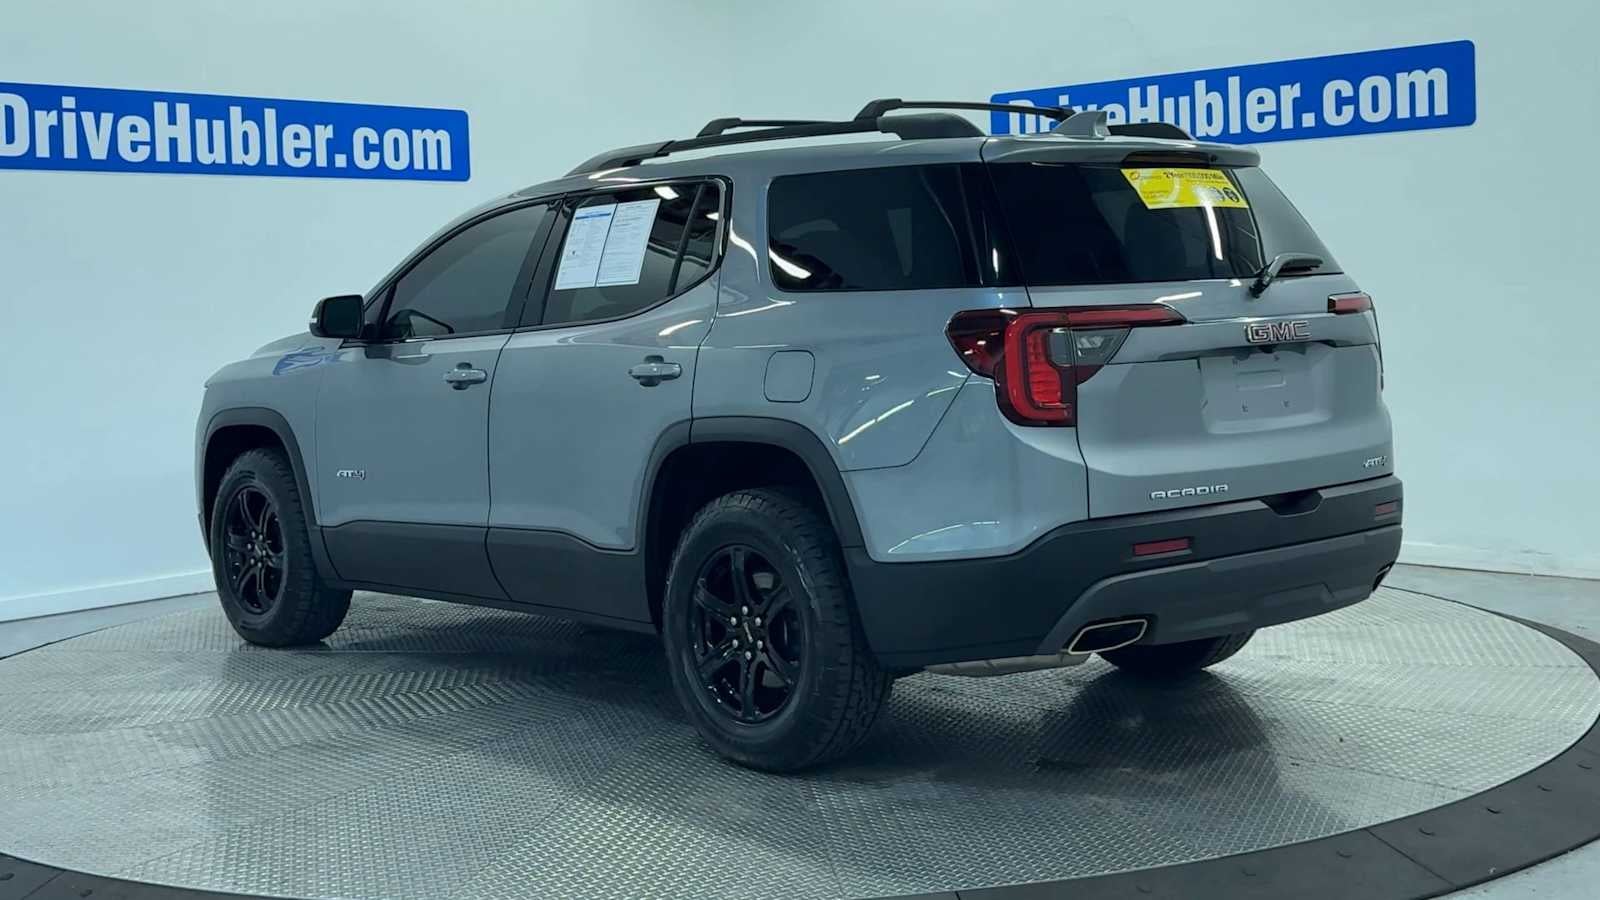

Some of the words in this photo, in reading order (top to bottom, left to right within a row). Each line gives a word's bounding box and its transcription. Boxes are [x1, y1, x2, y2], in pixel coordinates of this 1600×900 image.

[1008, 66, 1449, 138] DHubler.com
[0, 92, 453, 171] DriveHubler.com
[1246, 320, 1313, 343] GMC
[1150, 483, 1229, 500] ACADIA
